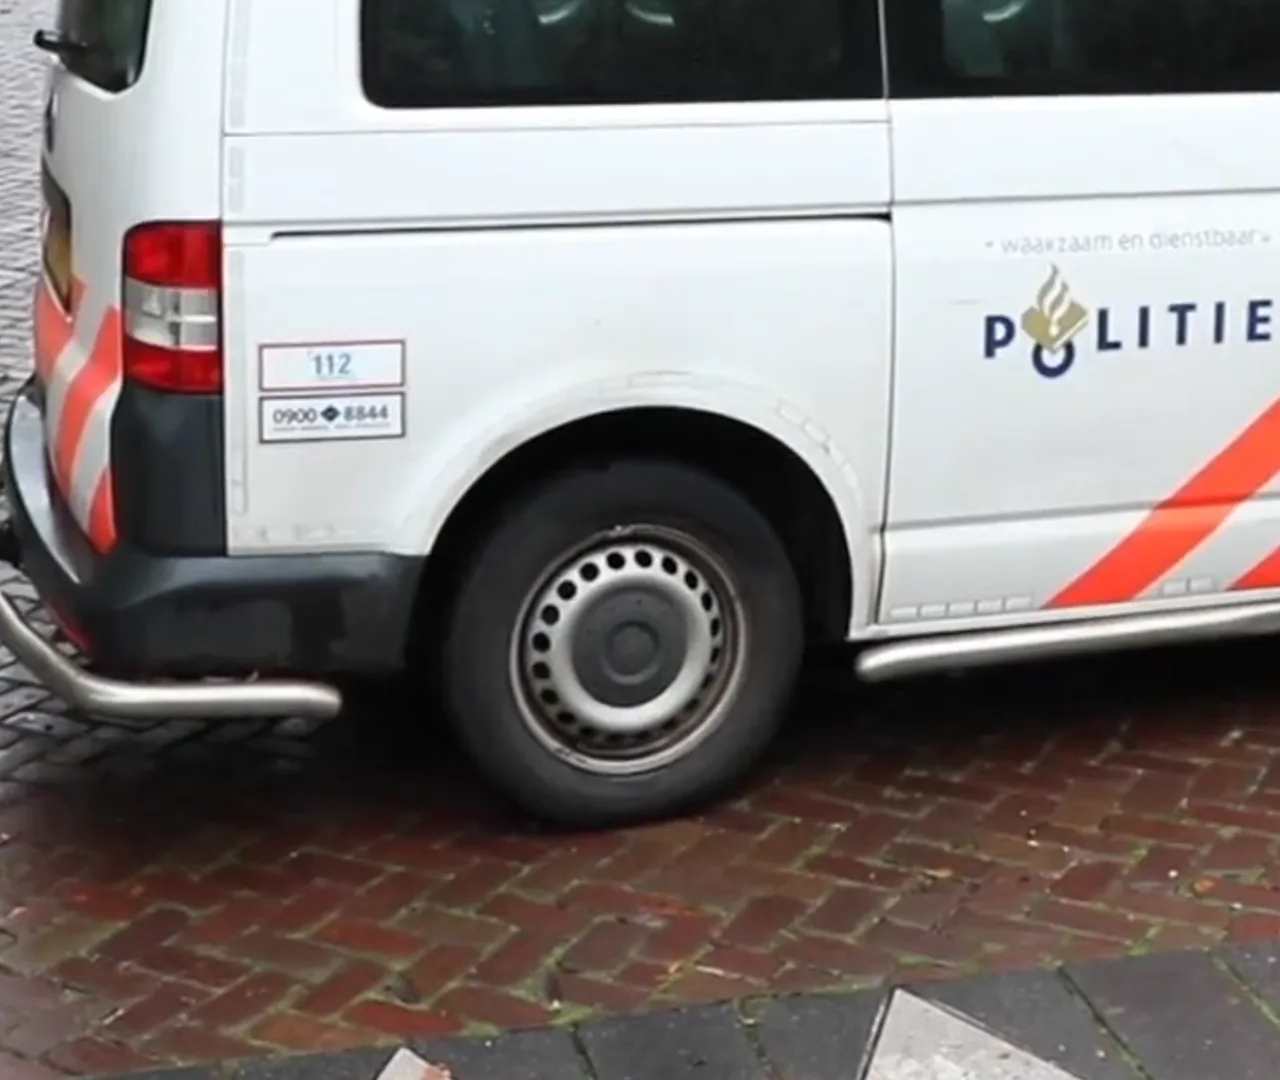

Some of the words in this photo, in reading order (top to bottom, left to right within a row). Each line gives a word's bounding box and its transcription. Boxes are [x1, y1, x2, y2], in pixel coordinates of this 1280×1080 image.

[1001, 235, 1113, 255] waakzaam
[1118, 234, 1144, 251] en
[1148, 228, 1259, 251] dienstbaar
[983, 299, 1273, 379] POLITIE
[314, 353, 352, 376] 112
[272, 407, 318, 424] 0900
[343, 404, 389, 422] 8844
